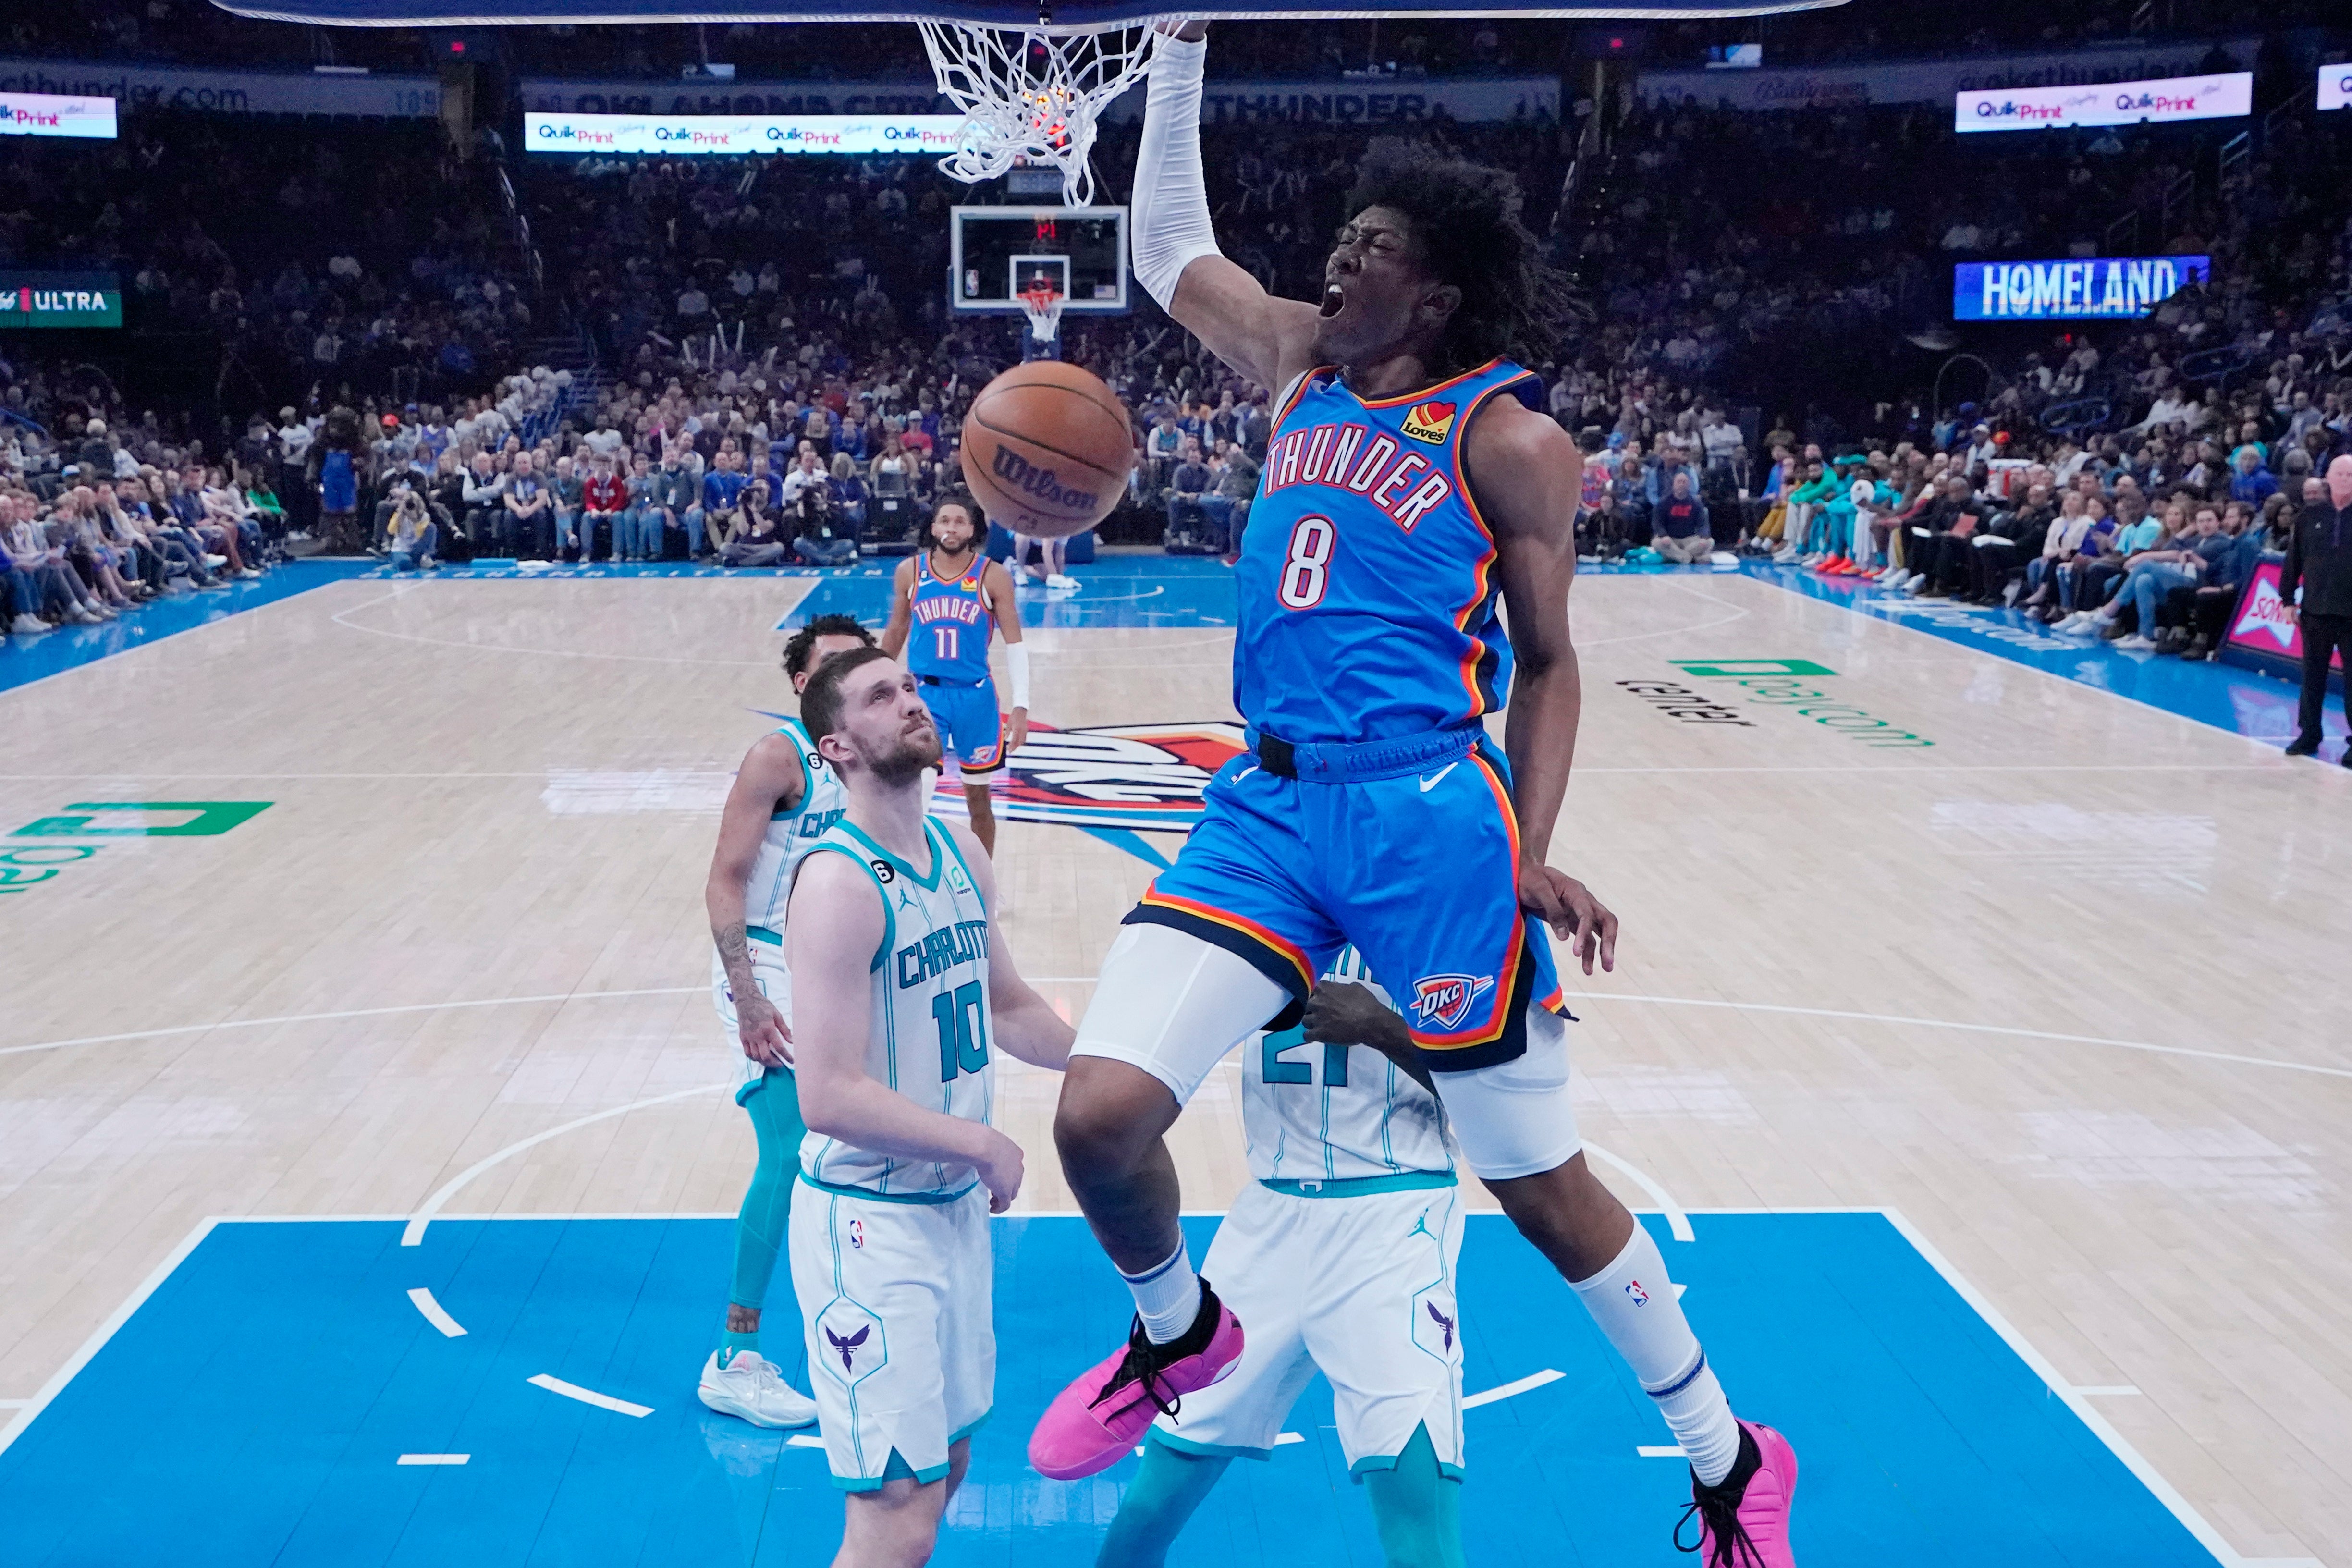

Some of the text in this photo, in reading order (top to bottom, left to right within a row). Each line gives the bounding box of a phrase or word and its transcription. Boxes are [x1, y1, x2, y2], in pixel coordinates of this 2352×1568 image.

[1229, 11, 1392, 20] BASKETBALL
[1206, 95, 1425, 125] THUNDER
[34, 291, 108, 311] ULTRA
[1982, 260, 2176, 315] HOMELAND
[992, 443, 1099, 510] Wilson
[1264, 423, 1453, 535] THUNDER
[1277, 513, 1337, 612] 8
[913, 597, 980, 624] THUNDER
[934, 628, 957, 658] 11
[809, 755, 823, 769] 6
[872, 863, 890, 882] 6
[1421, 983, 1460, 1017] OKC
[932, 979, 989, 1083] 10
